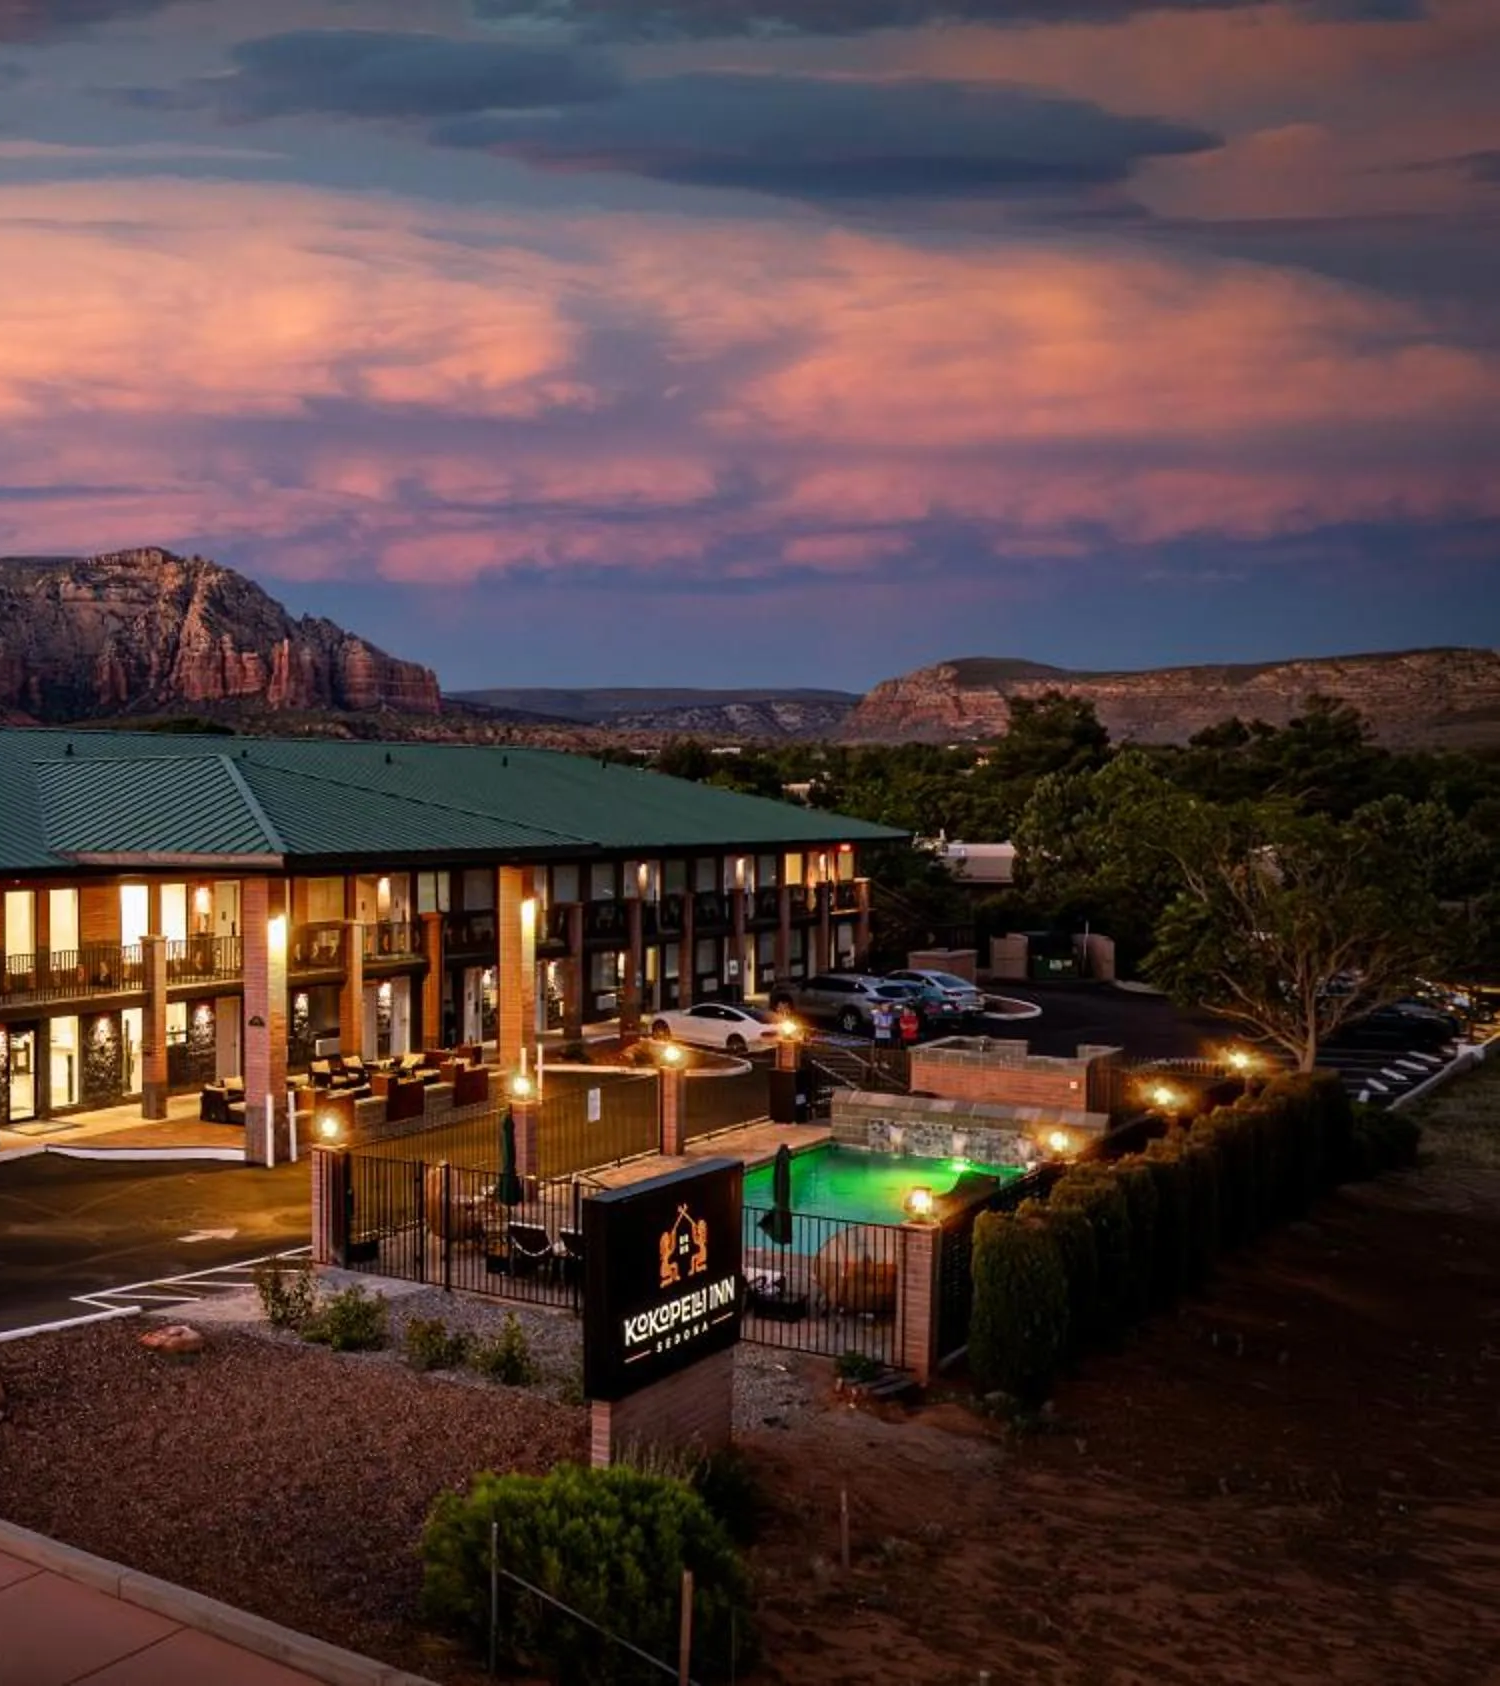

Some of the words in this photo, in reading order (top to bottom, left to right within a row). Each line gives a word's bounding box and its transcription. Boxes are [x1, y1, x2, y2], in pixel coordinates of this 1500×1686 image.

[624, 1287, 707, 1347] KOKOPELLI
[709, 1275, 735, 1310] INN
[657, 1321, 708, 1353] SEDONA
